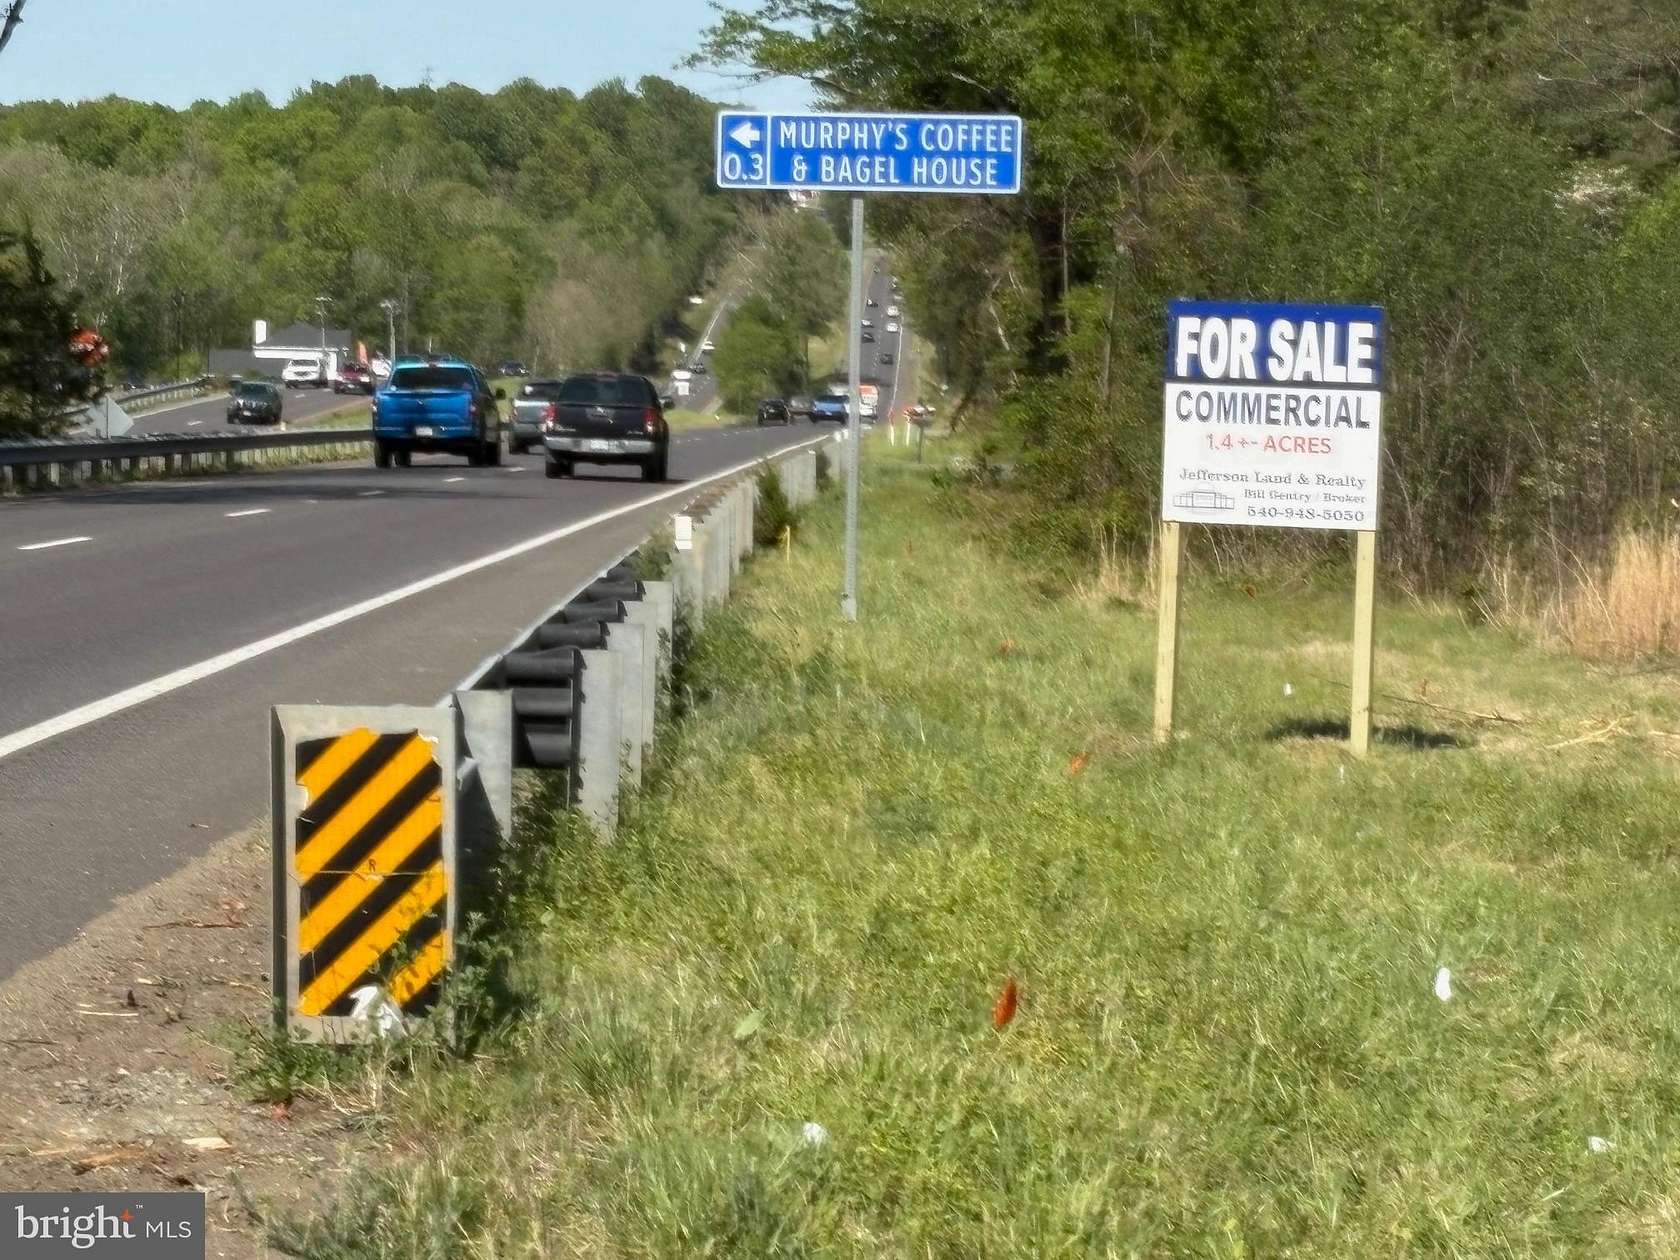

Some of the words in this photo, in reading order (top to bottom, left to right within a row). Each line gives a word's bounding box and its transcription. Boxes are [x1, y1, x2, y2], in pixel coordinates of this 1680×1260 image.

[779, 121, 908, 151] MURPHY'S
[921, 123, 1012, 152] COFFEE
[723, 153, 764, 181] 0.3
[792, 156, 807, 182] &
[821, 156, 899, 184] BAGEL
[913, 157, 998, 186] HOUSE
[1176, 316, 1257, 380] FOR
[1267, 318, 1374, 383] SALE
[1175, 389, 1371, 429] COMMERCIAL
[1264, 435, 1332, 454] ACRES
[1179, 467, 1249, 483] Jefferson
[1255, 471, 1292, 485] Land
[1297, 473, 1310, 485] &
[1315, 474, 1367, 490] Realty
